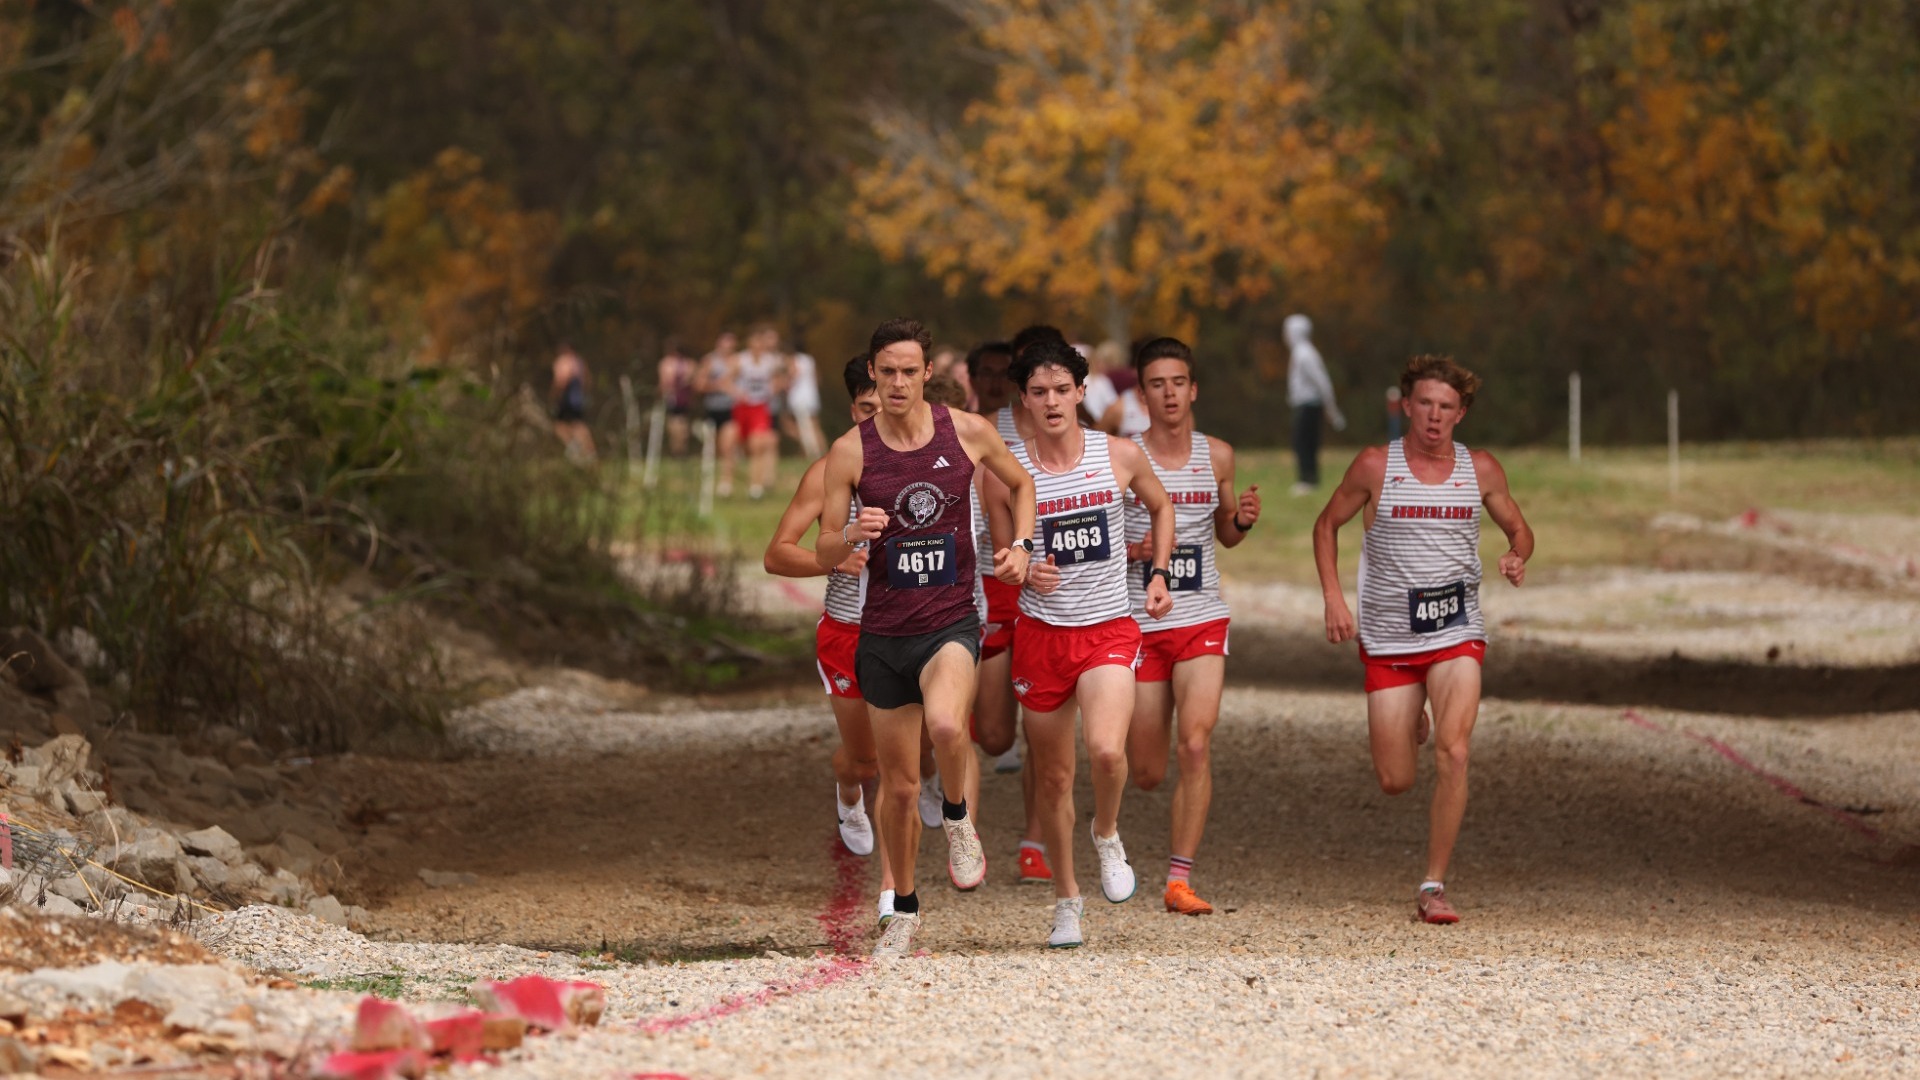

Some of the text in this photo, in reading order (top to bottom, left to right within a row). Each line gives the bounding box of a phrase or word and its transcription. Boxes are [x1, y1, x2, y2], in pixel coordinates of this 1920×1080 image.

[1036, 490, 1113, 516] MBERLANDS
[1081, 516, 1097, 524] KING
[1052, 526, 1102, 551] 4663
[897, 550, 945, 573] 4617
[1416, 596, 1459, 621] 4653
